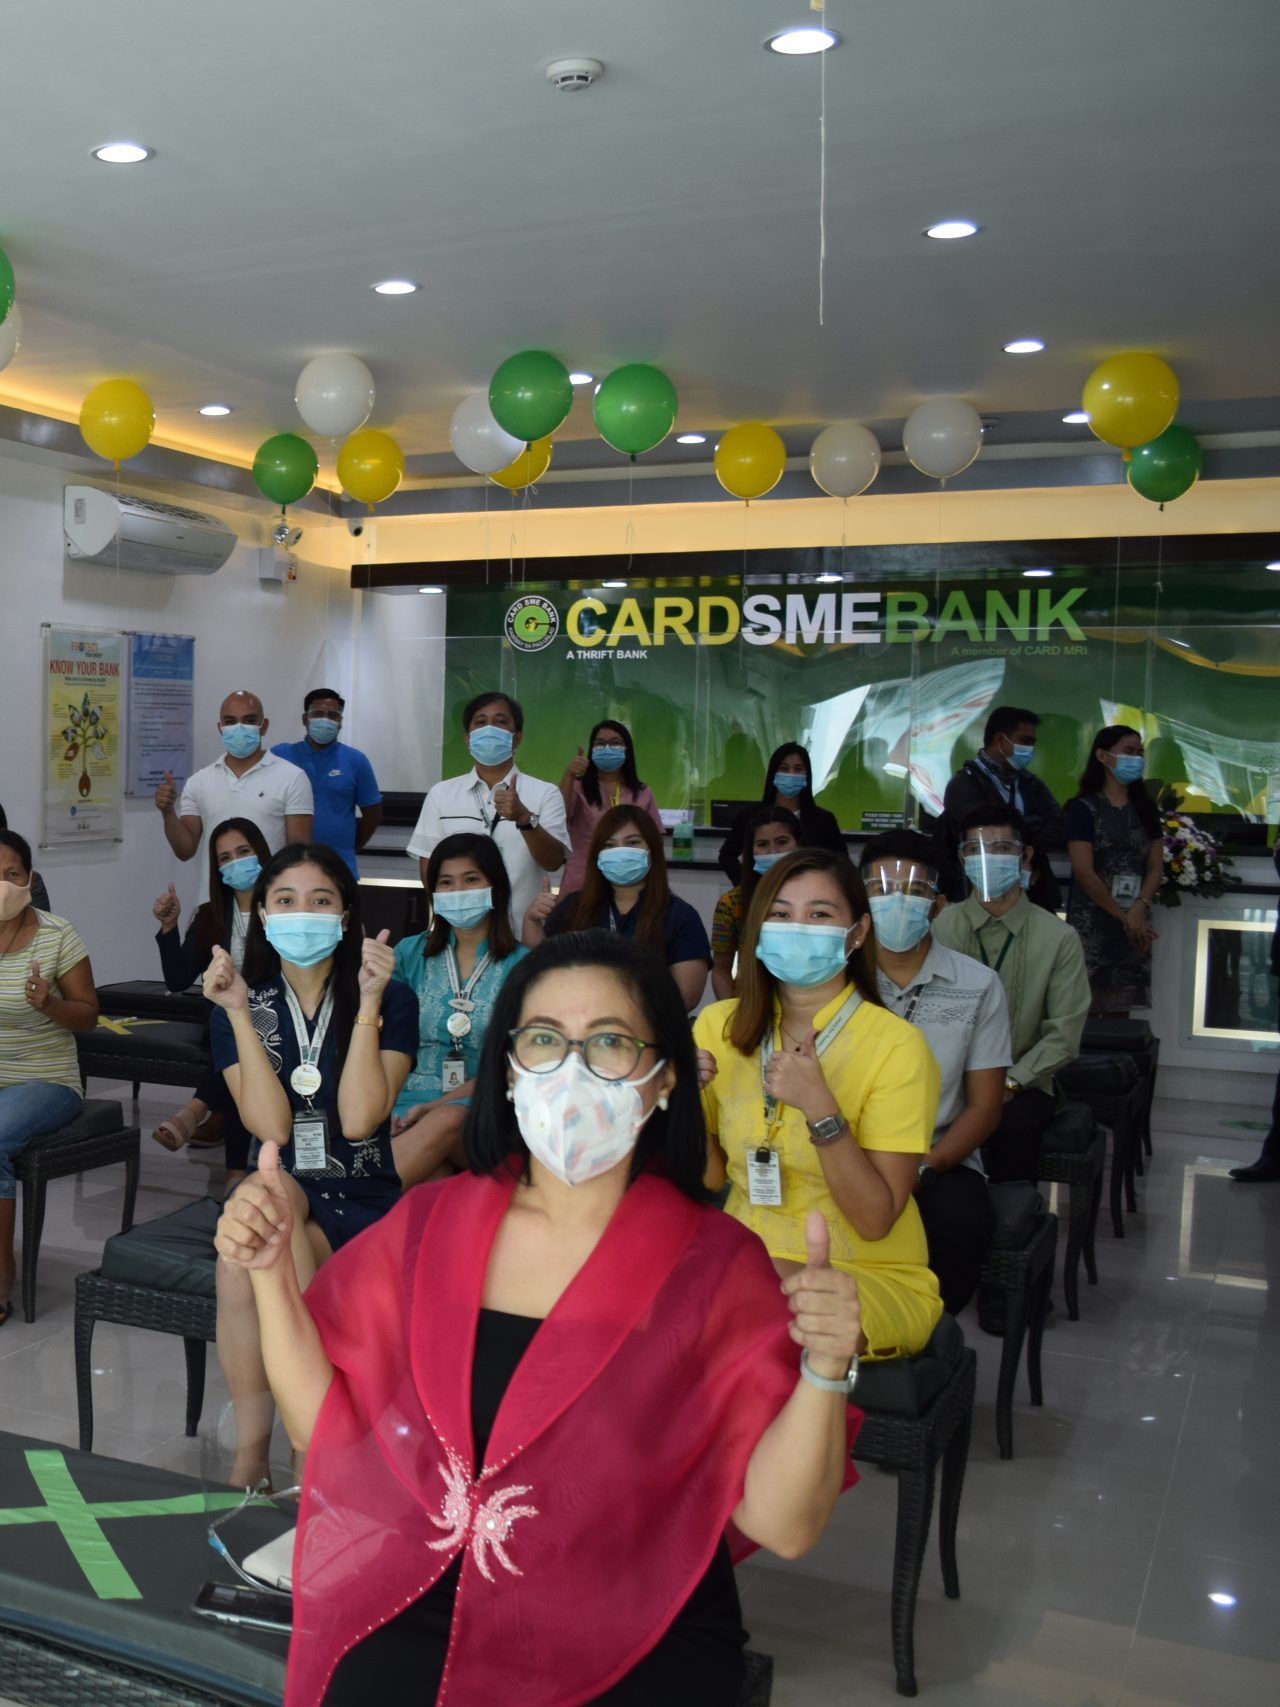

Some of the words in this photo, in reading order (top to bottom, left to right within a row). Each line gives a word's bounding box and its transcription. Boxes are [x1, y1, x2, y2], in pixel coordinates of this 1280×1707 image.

[507, 602, 523, 623] CARD
[541, 602, 557, 623] BANK
[566, 650, 575, 659] A
[577, 650, 614, 659] THRIFT
[616, 650, 647, 659] BANK
[962, 647, 1008, 656] member
[1010, 646, 1022, 656] of
[1024, 646, 1061, 656] CARD
[1064, 646, 1088, 655] MRI
[50, 659, 74, 674] KNOW
[77, 661, 97, 676] YOUR
[99, 662, 120, 677] BANK
